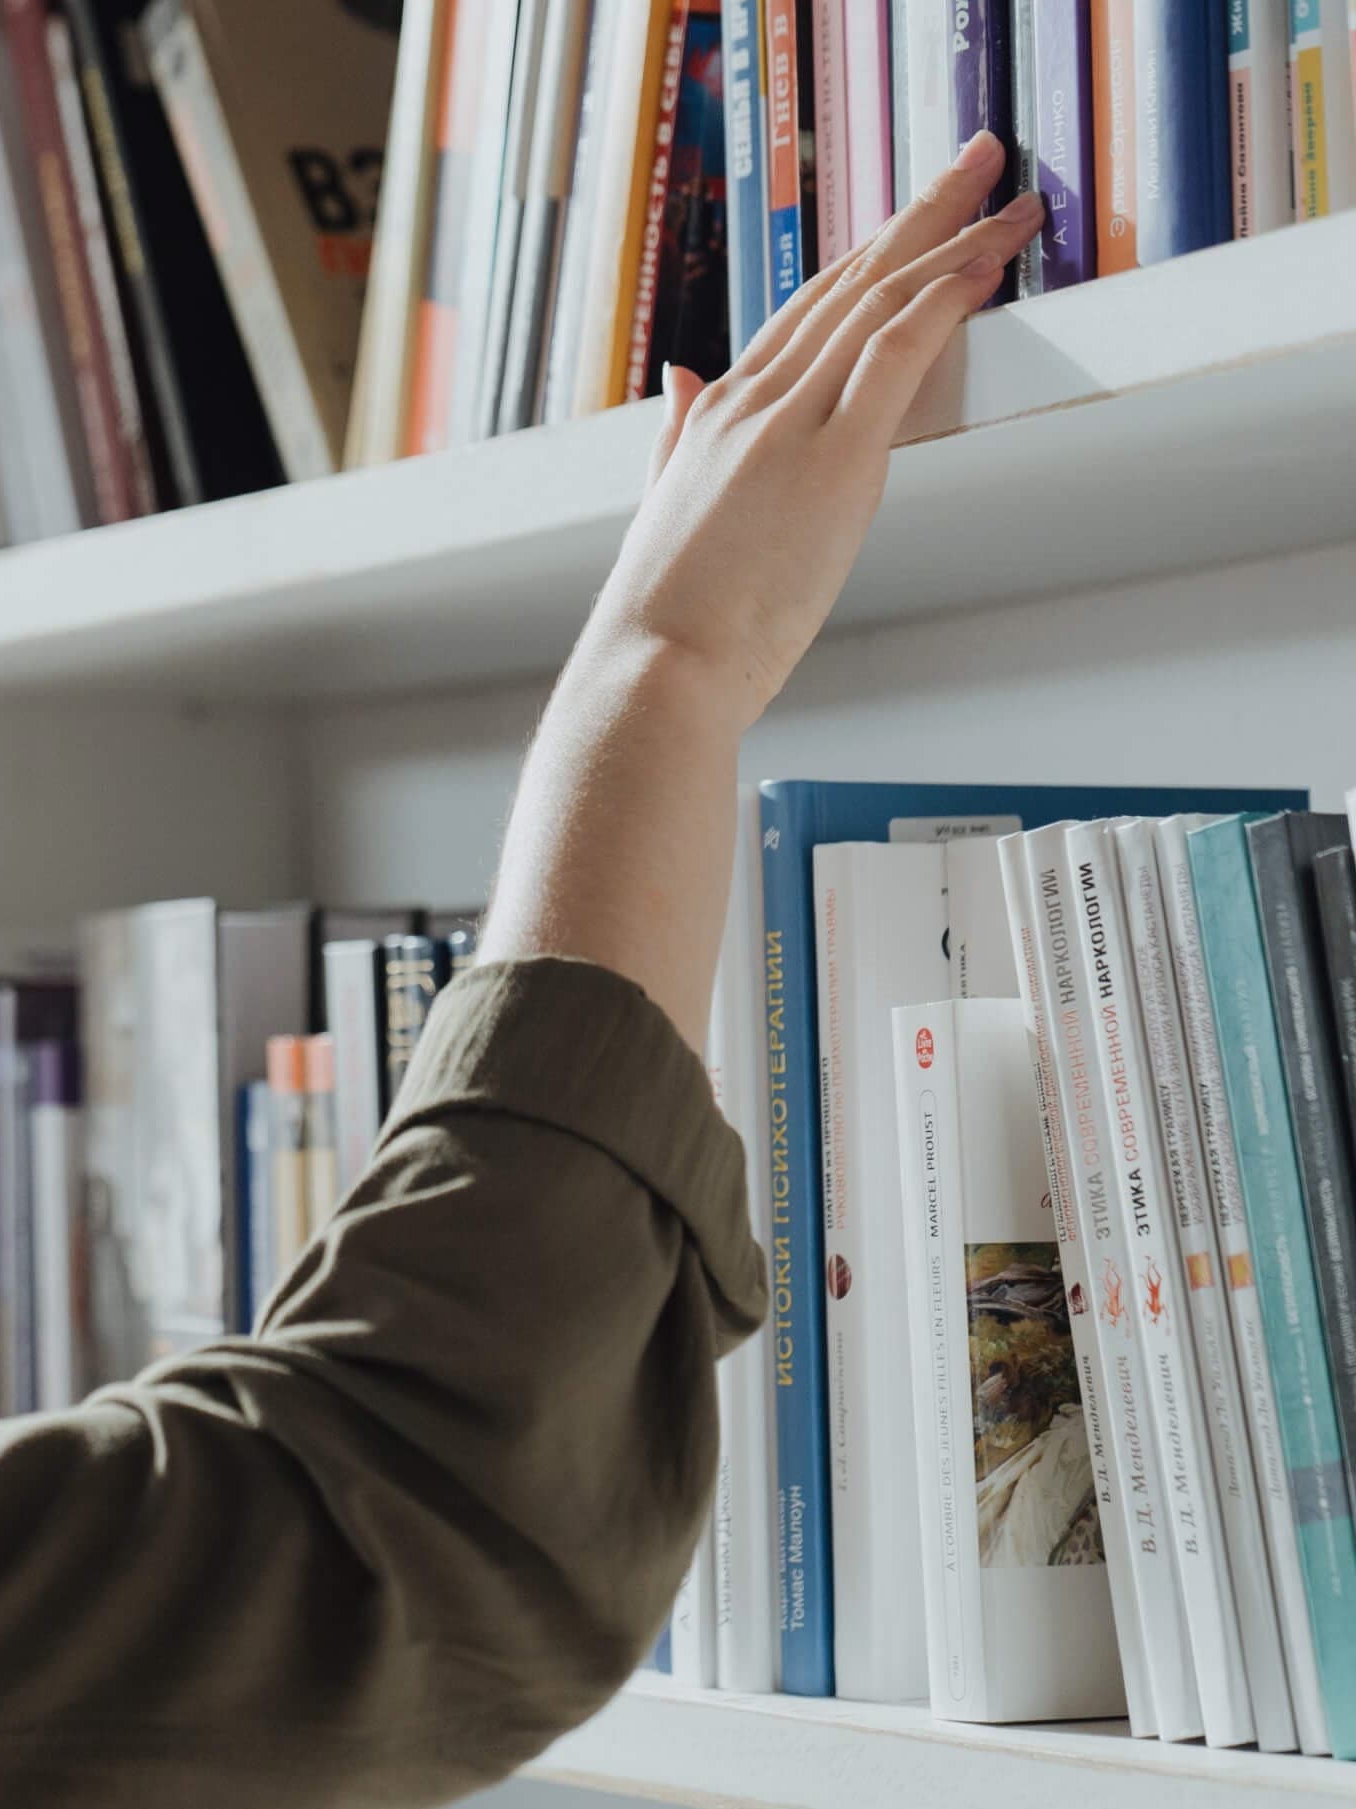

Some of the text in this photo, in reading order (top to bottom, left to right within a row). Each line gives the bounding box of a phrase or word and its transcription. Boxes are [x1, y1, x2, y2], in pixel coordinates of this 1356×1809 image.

[1051, 90, 1068, 245] А. Е. Личко
[1110, 167, 1128, 237] Эрик
[1039, 868, 1111, 1240] ЭТИКА СОВРЕМЕННОЙ НАРКОЛОГИИ
[1078, 863, 1151, 1236] ЭТИКА СОВРЕМЕННОЙ НАРКОЛОГИИ
[765, 930, 793, 1387] ИСТОКИ ПСИХОТЕРАПИИ
[924, 1112, 938, 1238] MARCEL PROUST
[930, 1255, 943, 1312] FLEURS
[934, 1318, 945, 1337] EN
[935, 1343, 948, 1390] FILLES
[938, 1395, 950, 1451] JEUNES
[1081, 1356, 1111, 1504] В. Д. Менделевич
[941, 1456, 952, 1486] DES
[1115, 1356, 1157, 1554] В. Д. Менделевич
[1157, 1353, 1200, 1556] В. Д. Менделевич
[787, 1486, 806, 1632] Томас Малоун
